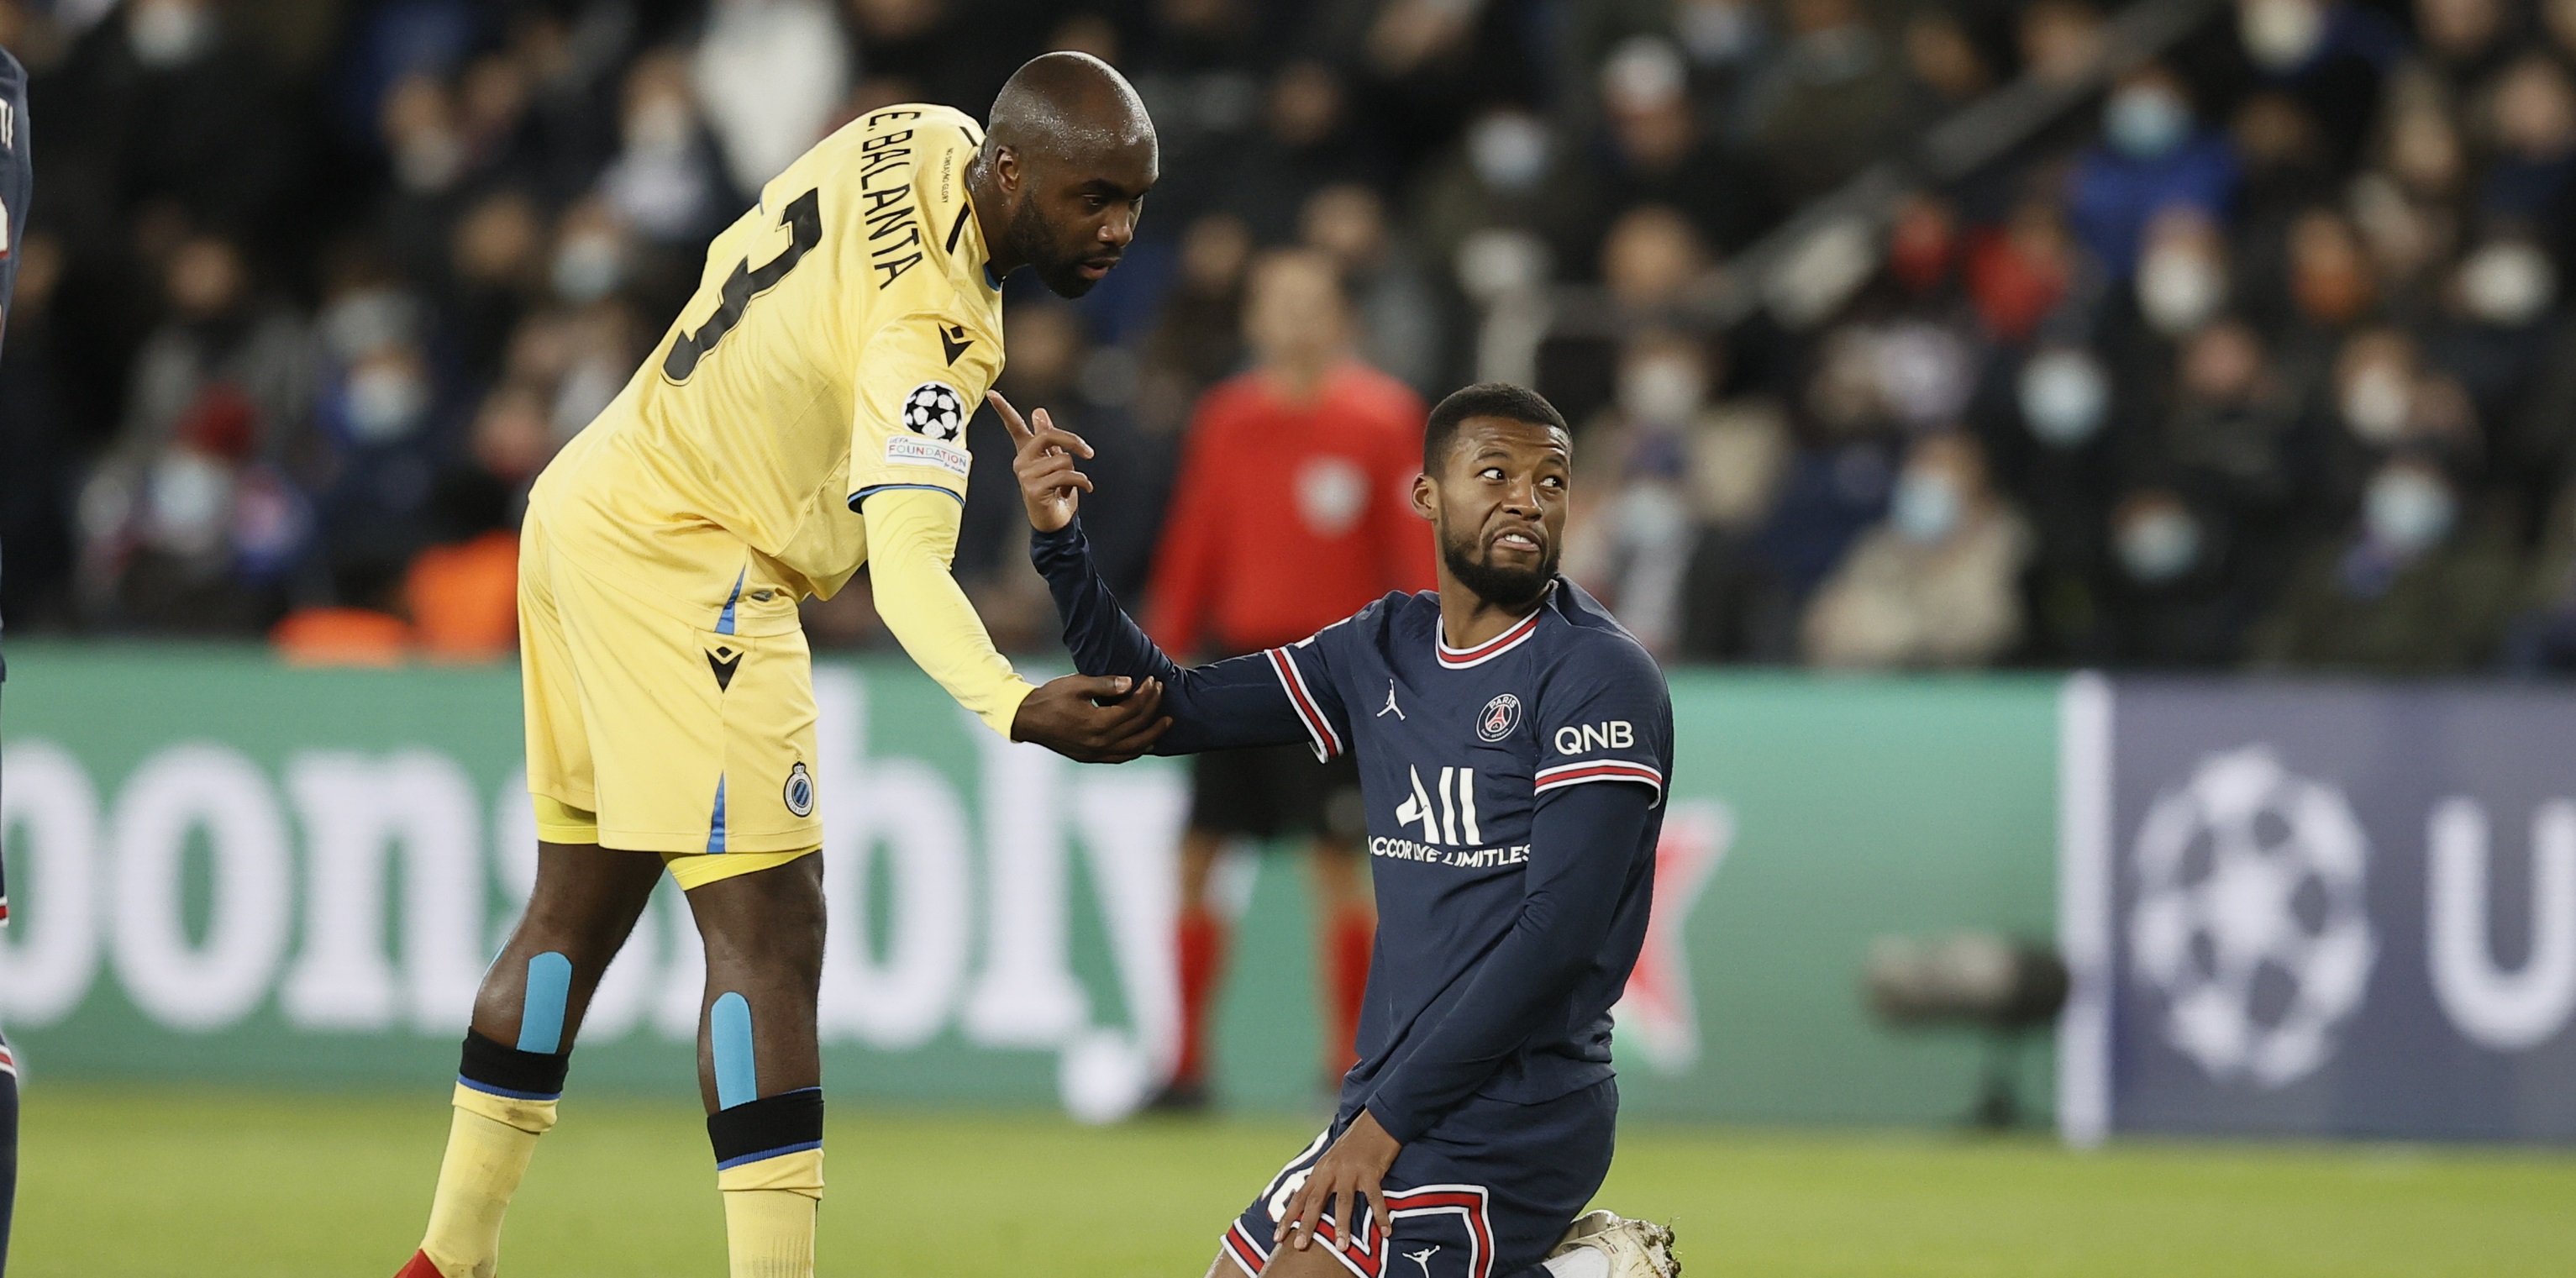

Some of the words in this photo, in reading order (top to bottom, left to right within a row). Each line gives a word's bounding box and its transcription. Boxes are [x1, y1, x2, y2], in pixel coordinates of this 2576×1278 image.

[889, 444, 966, 466] FOUNDATION
[1489, 696, 1517, 709] PARIS
[1554, 720, 1635, 755] QNB
[2426, 792, 2576, 1052] U
